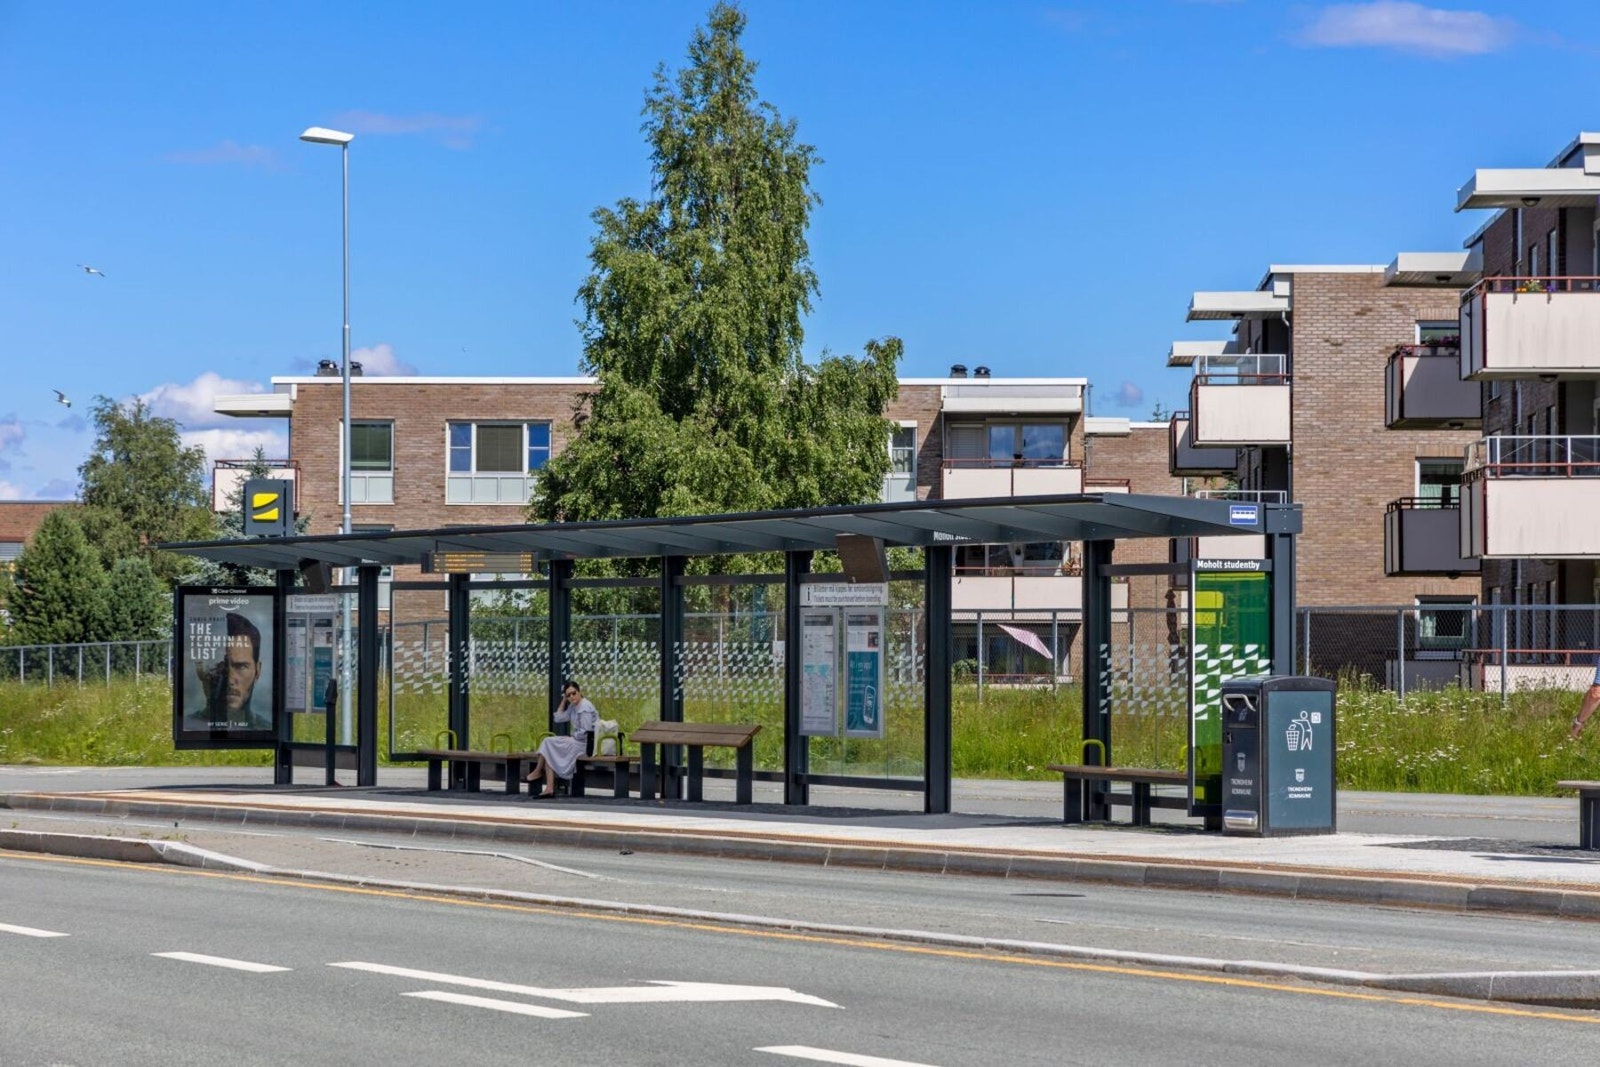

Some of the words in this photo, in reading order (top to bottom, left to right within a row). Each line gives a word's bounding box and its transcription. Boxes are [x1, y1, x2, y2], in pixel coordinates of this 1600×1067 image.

[1197, 560, 1223, 569] Moholt
[1224, 560, 1260, 571] studentby
[208, 597, 229, 606] prime
[230, 597, 250, 605] video
[189, 623, 213, 635] THE
[189, 635, 251, 648] TERMINAL
[190, 648, 217, 660] LIST
